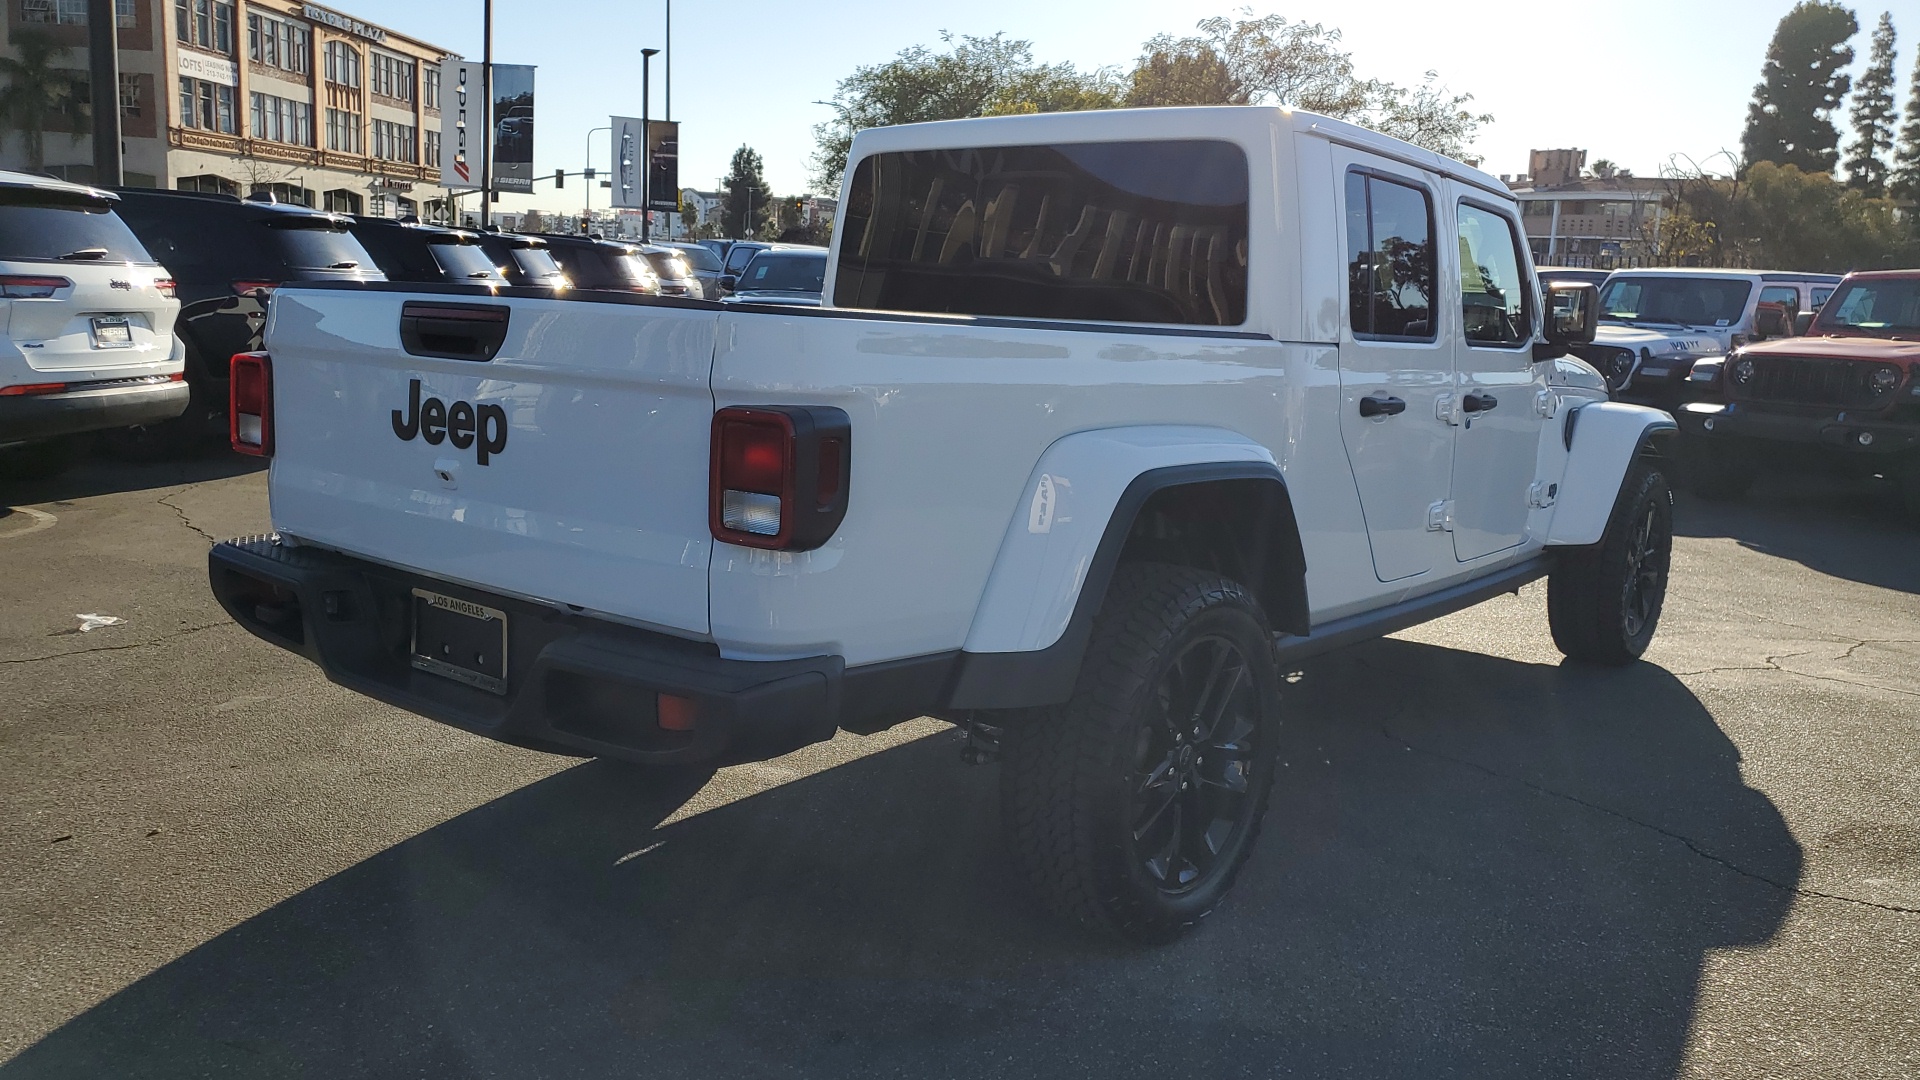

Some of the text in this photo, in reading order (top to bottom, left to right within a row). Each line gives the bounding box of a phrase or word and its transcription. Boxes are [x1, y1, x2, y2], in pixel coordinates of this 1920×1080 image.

[352, 22, 387, 43] PLAZA
[179, 57, 202, 72] LOFTS
[500, 177, 531, 186] SIERRA
[392, 379, 507, 466] Jeep
[434, 595, 485, 617] LOS ANGELES
